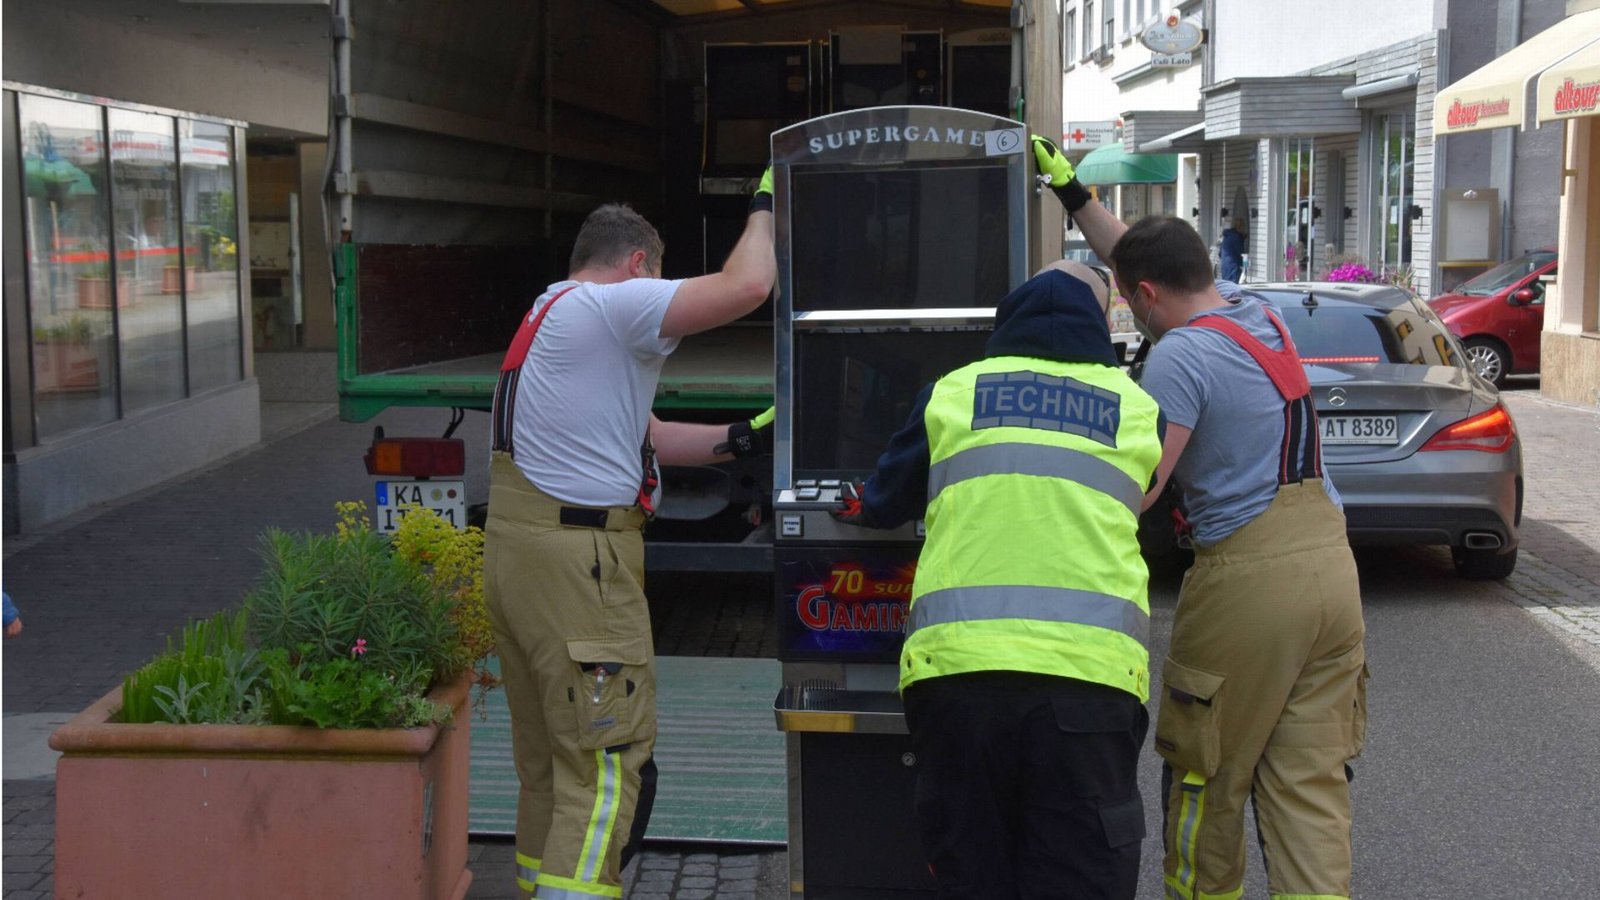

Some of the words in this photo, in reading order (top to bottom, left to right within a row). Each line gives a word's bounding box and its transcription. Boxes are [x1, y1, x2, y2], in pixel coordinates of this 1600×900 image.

[809, 125, 985, 153] SUPERGAME
[976, 386, 1116, 432] TECHNIK
[1325, 418, 1347, 437] AT
[1352, 418, 1395, 437] 8389
[395, 486, 424, 507] KA
[831, 570, 864, 594] 70
